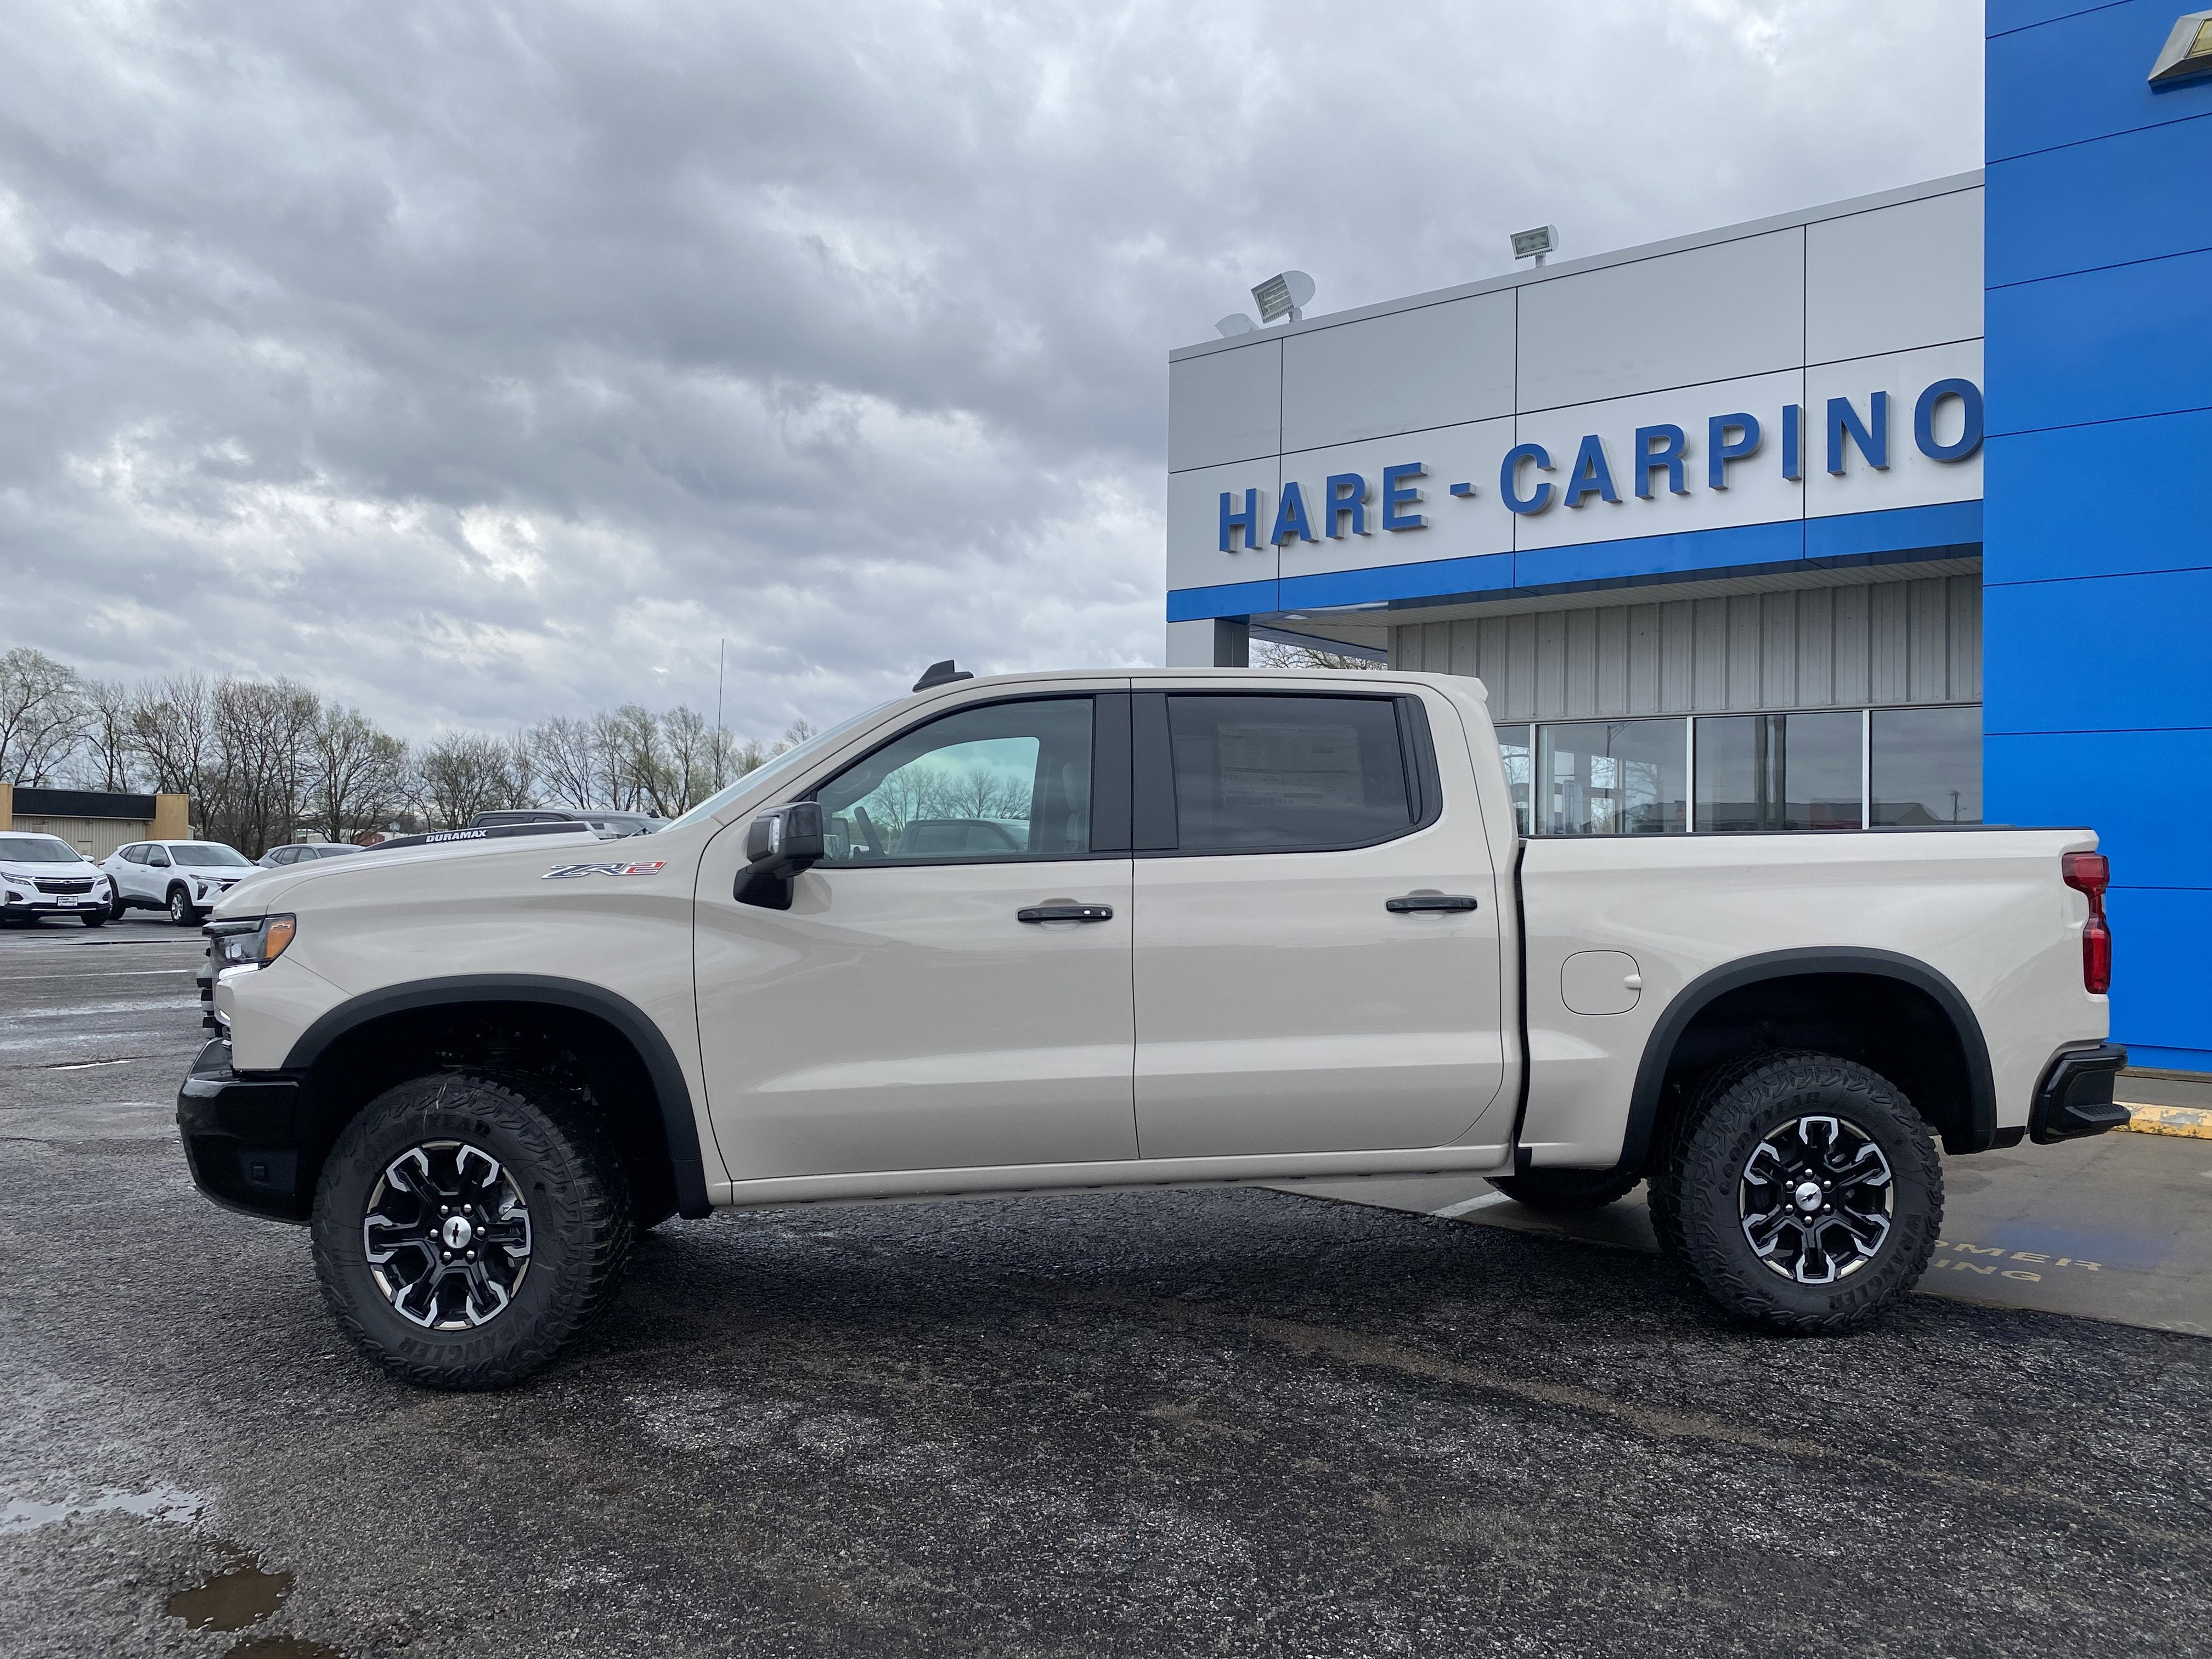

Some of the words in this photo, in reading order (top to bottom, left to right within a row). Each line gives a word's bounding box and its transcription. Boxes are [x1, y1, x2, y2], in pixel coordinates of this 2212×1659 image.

[1219, 462, 1428, 552] HARE
[1500, 378, 1984, 515] CARPINO
[426, 830, 487, 843] DURAMAX
[541, 861, 667, 879] ZR2
[1827, 1214, 1922, 1310] WRANGLER
